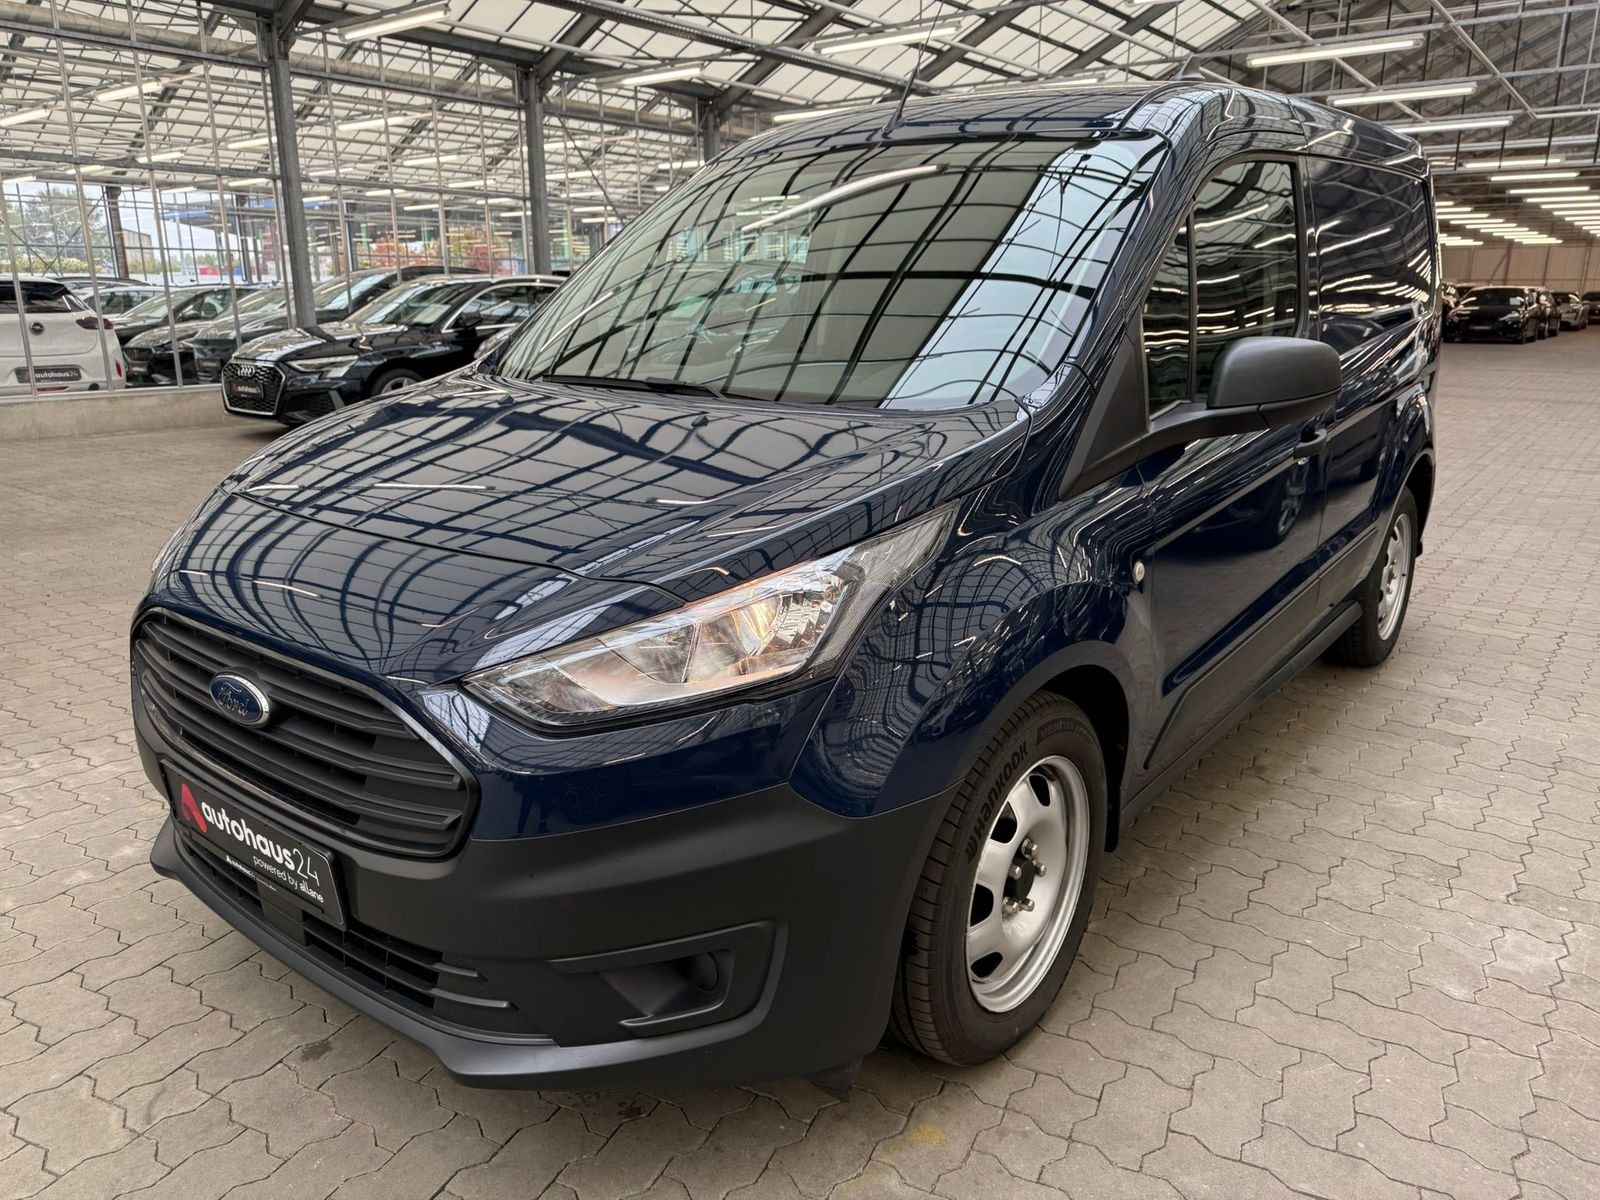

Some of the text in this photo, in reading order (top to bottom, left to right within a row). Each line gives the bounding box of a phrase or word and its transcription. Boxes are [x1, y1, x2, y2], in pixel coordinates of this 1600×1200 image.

[217, 681, 250, 716] Ford
[201, 801, 320, 886] autohaus24
[253, 855, 287, 881] powered
[288, 872, 298, 889] by
[299, 880, 324, 903] allane
